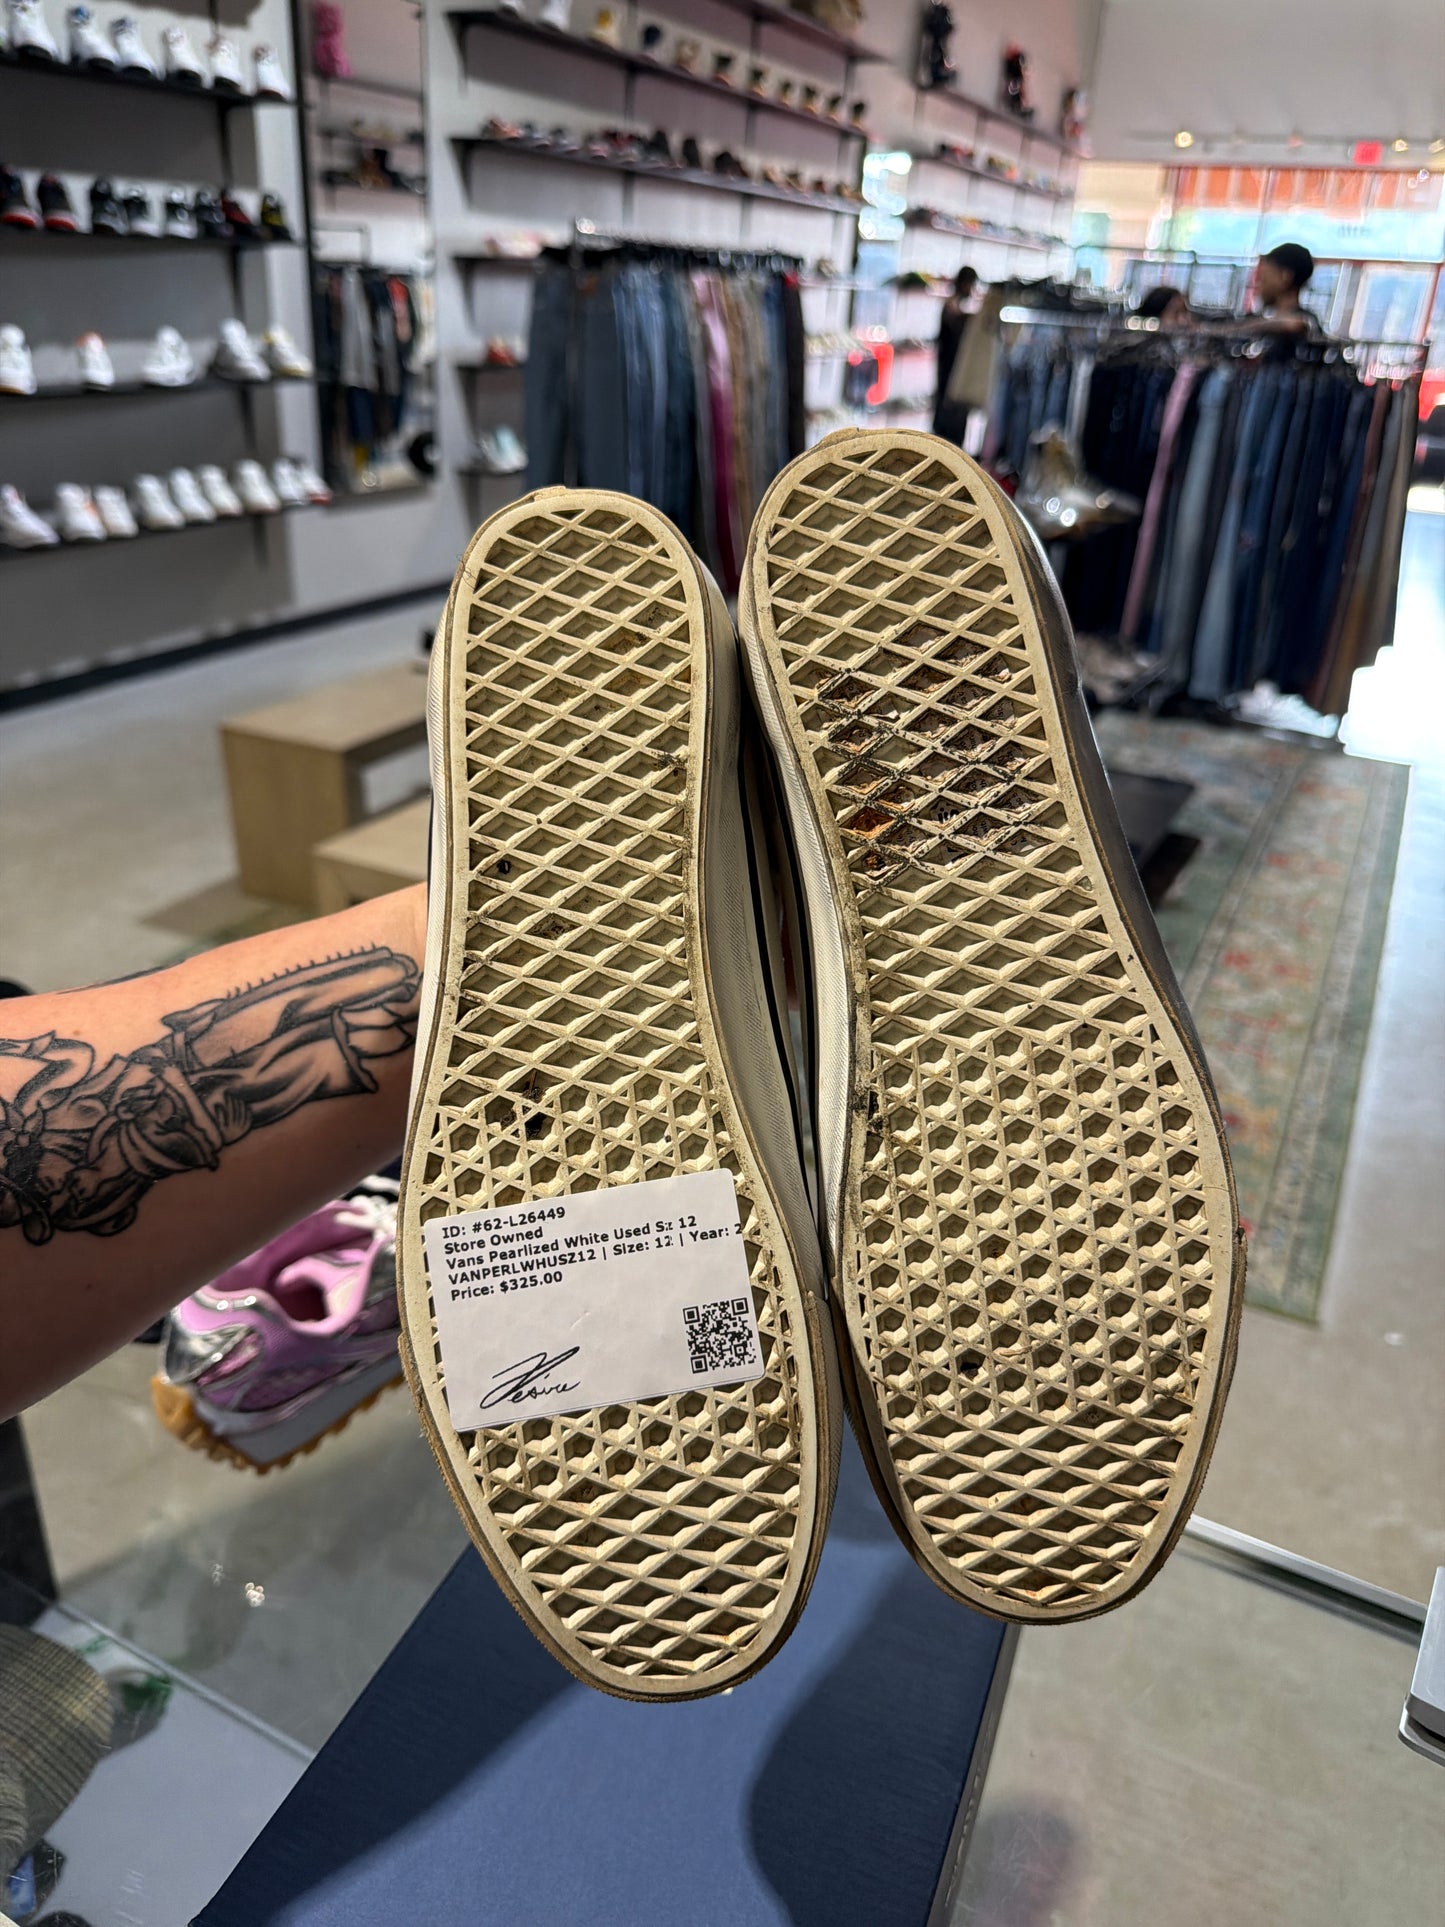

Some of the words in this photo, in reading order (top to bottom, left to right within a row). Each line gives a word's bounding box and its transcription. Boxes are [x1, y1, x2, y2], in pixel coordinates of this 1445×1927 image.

[442, 1225, 466, 1239] ID:
[472, 1206, 566, 1233] #62-L26449
[444, 1239, 486, 1255] Store
[490, 1226, 543, 1246] Owned
[446, 1255, 484, 1270] Vans
[489, 1239, 559, 1262] Pearlized
[564, 1232, 609, 1249] White
[613, 1223, 651, 1239] Used
[678, 1215, 697, 1229] 12
[448, 1248, 597, 1285] VANPERLWHUSZ12
[613, 1242, 650, 1256] Size:
[689, 1227, 729, 1242] Year:
[451, 1285, 495, 1301] Price:
[500, 1270, 563, 1294] $325.00
